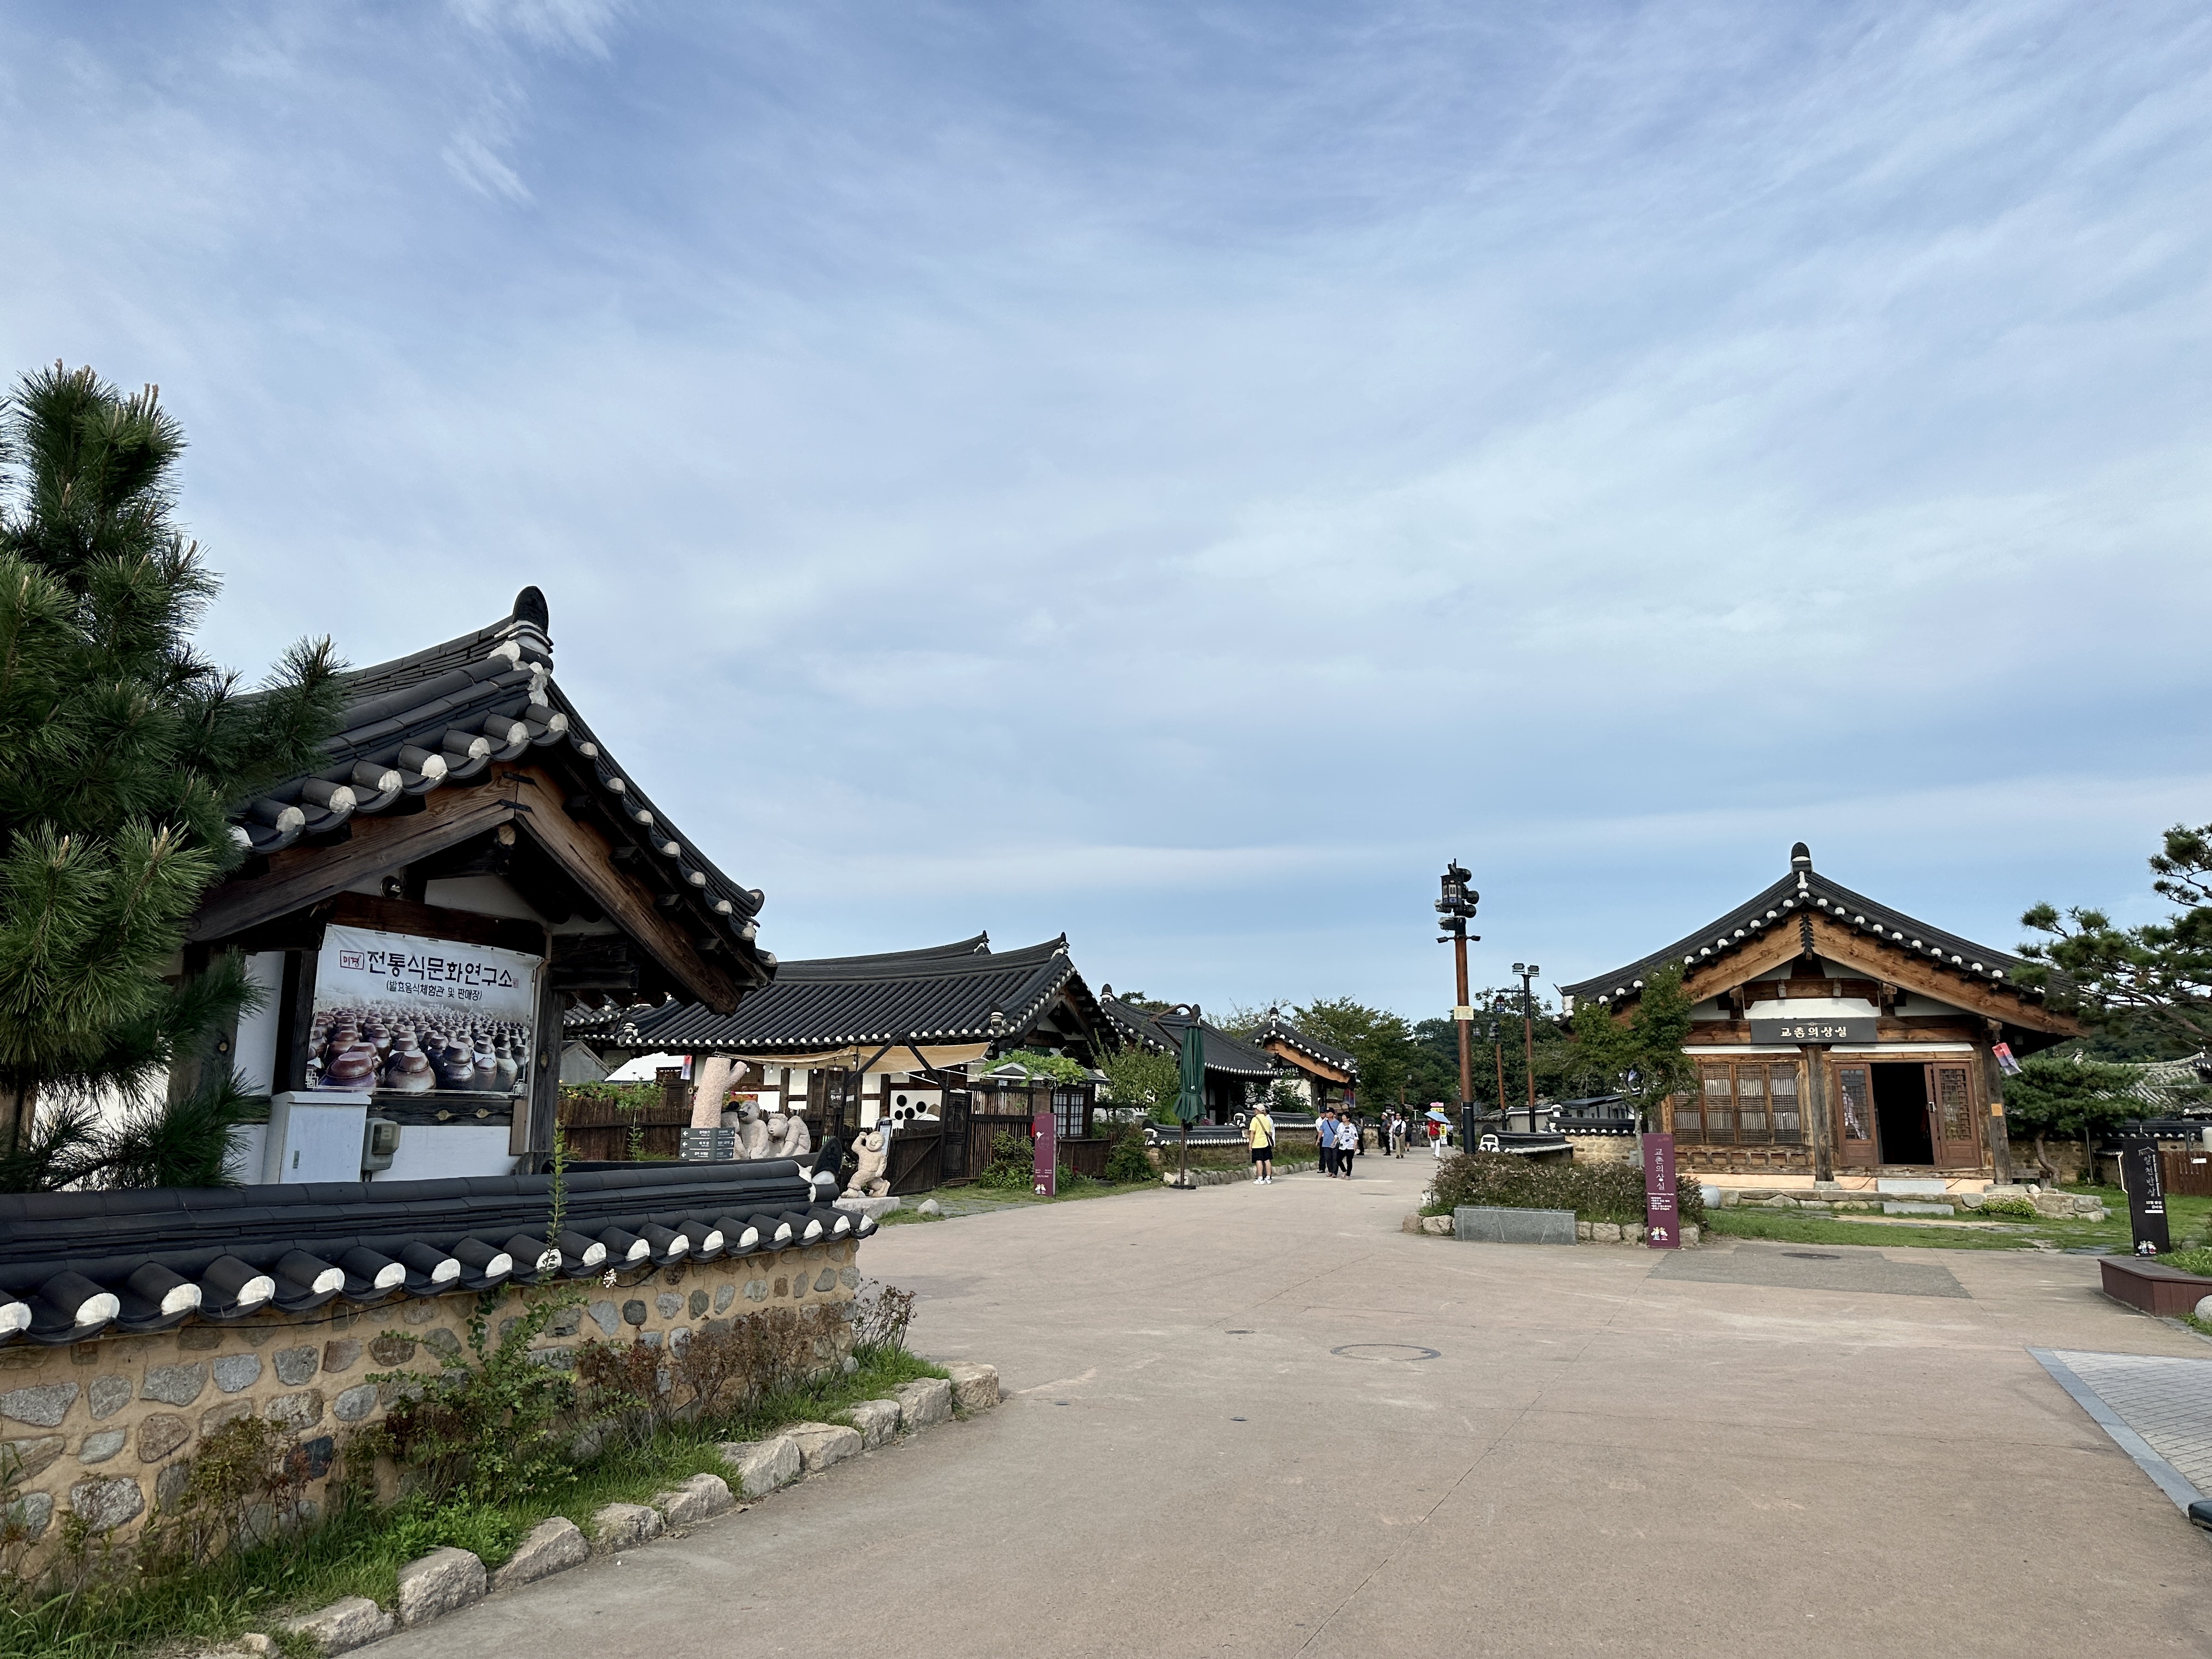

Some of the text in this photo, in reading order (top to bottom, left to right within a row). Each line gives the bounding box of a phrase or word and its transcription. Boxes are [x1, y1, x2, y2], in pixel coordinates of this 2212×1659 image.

[367, 951, 513, 987] 전통식문화연구소
[386, 979, 483, 1001] (발효음식체험관 및 판매장)
[1780, 1026, 1847, 1038] 교촌의상실
[1655, 1148, 1664, 1190] 교촌의상실
